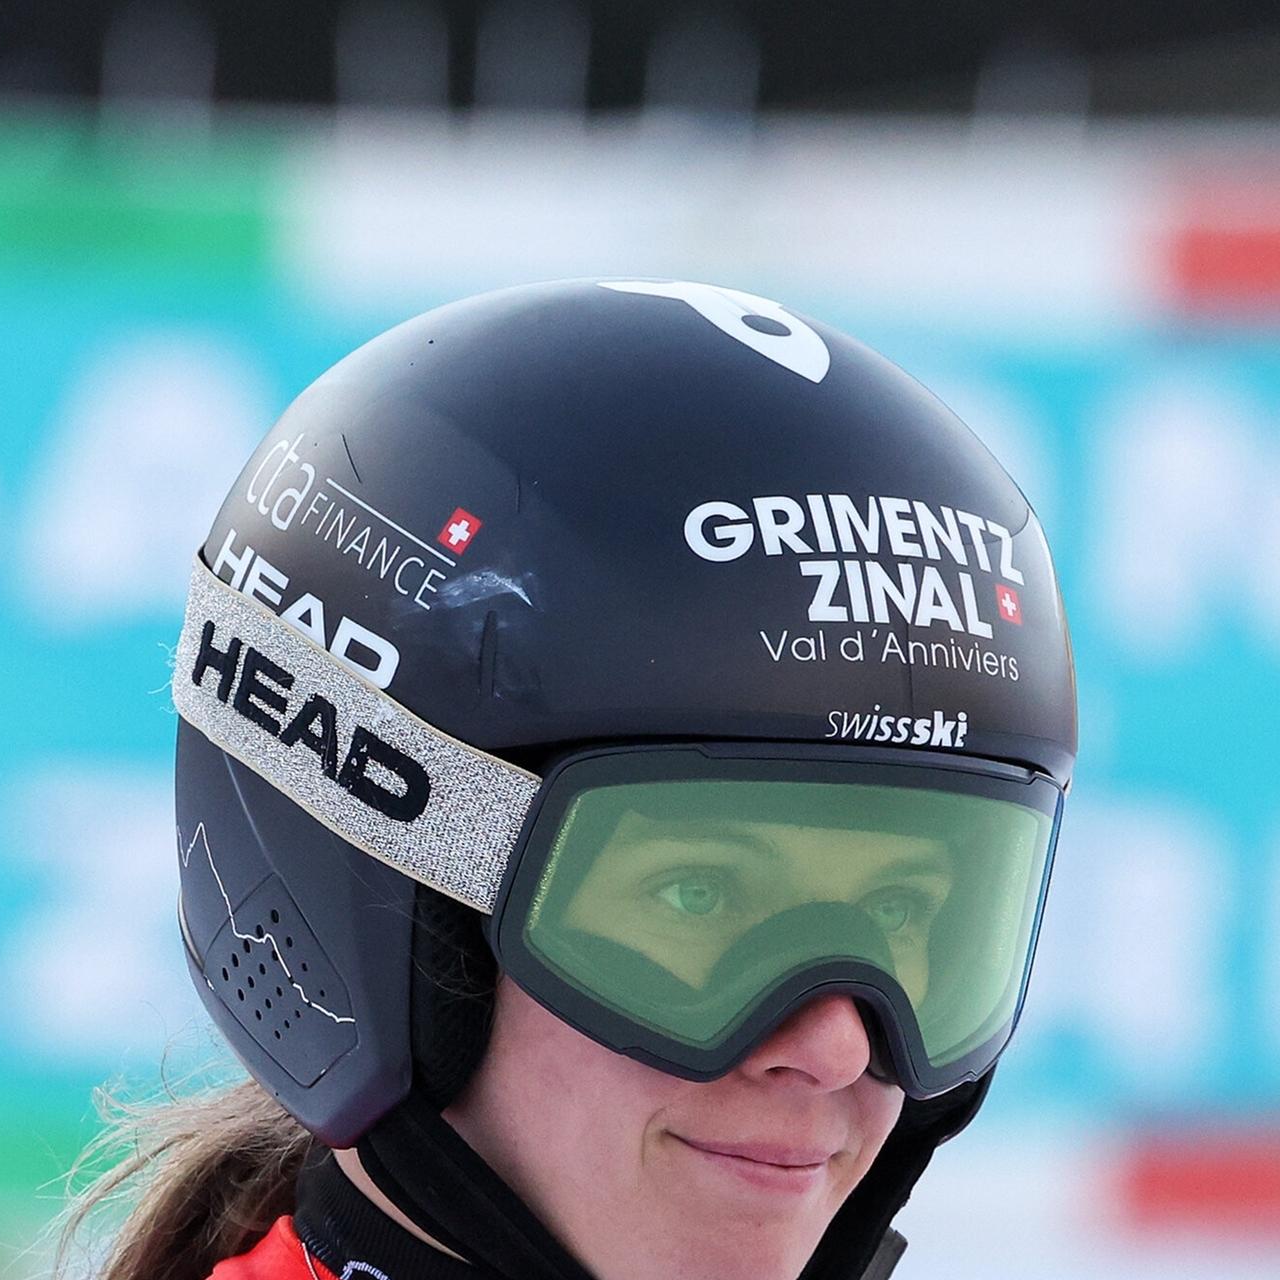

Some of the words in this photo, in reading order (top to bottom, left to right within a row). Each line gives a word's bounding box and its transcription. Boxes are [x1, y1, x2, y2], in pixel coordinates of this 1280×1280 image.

[246, 433, 315, 531] cta
[301, 491, 446, 611] FINANCE
[684, 494, 1024, 586] GRIMENTZ
[212, 528, 400, 690] HEAD
[759, 630, 826, 661] Val
[799, 560, 993, 639] ZINAL
[192, 620, 431, 823] HEAD
